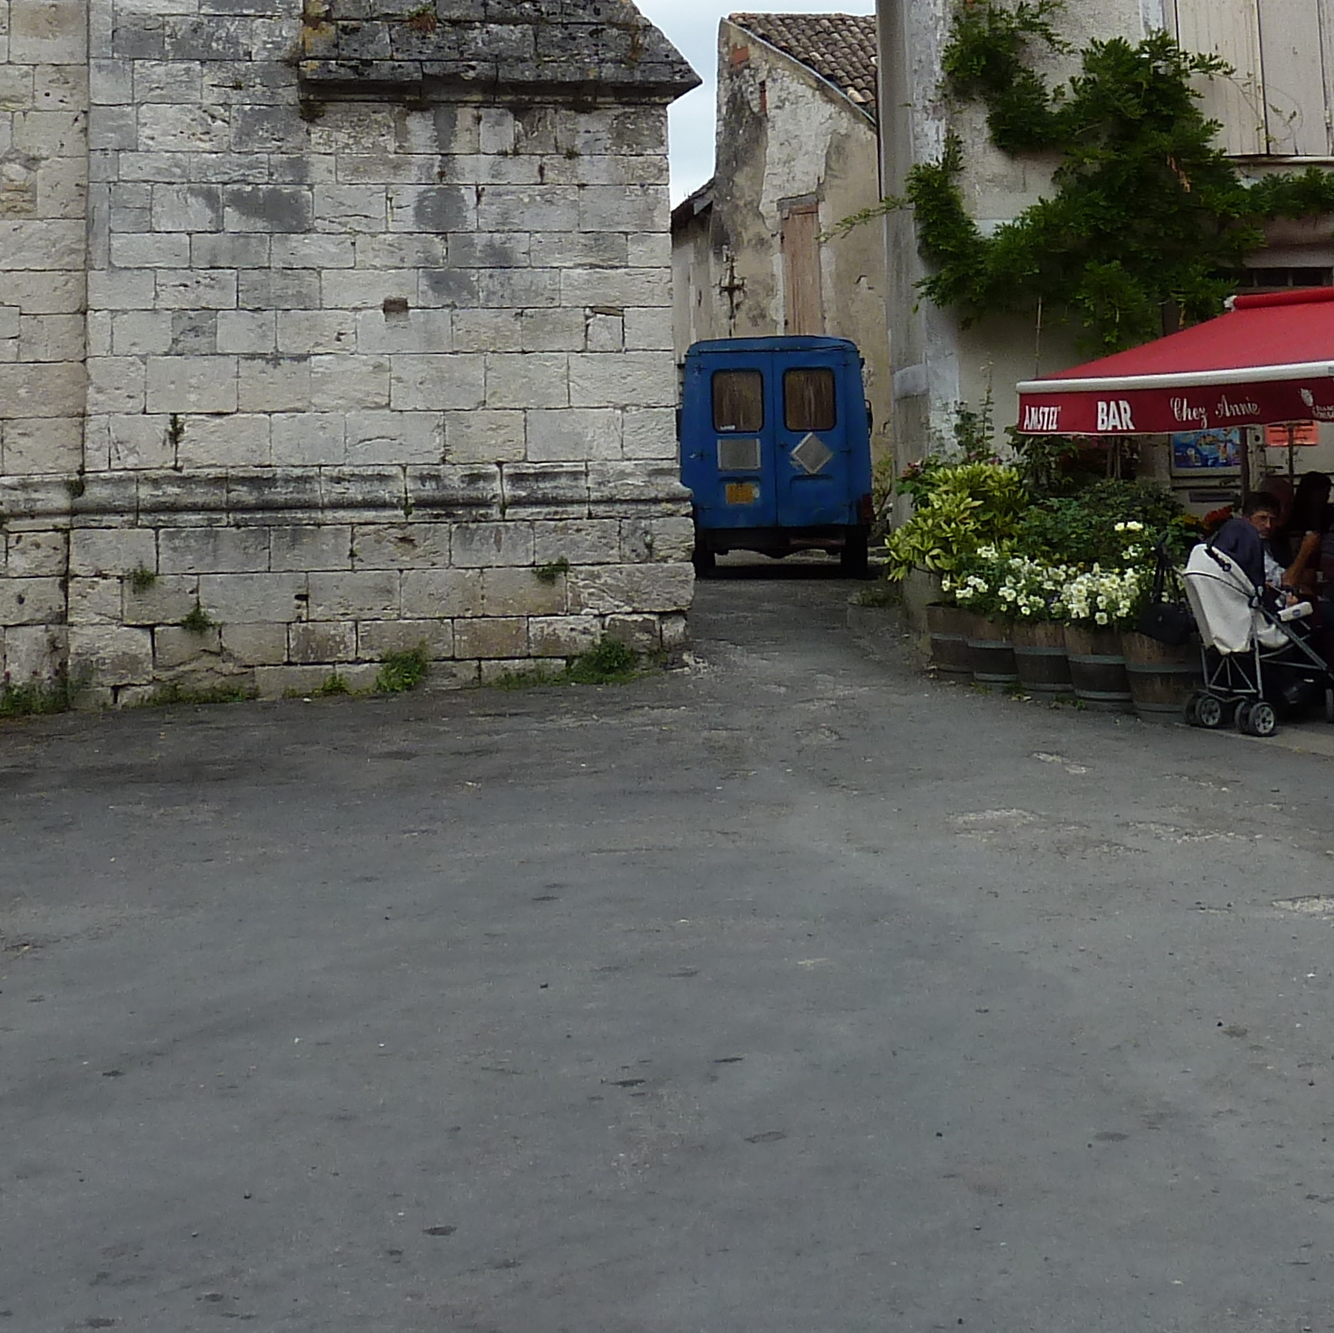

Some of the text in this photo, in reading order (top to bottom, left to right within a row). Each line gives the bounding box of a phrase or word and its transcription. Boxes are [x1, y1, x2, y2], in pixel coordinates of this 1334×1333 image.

[1023, 394, 1261, 431] AMSTEL BAR Chez Annie
